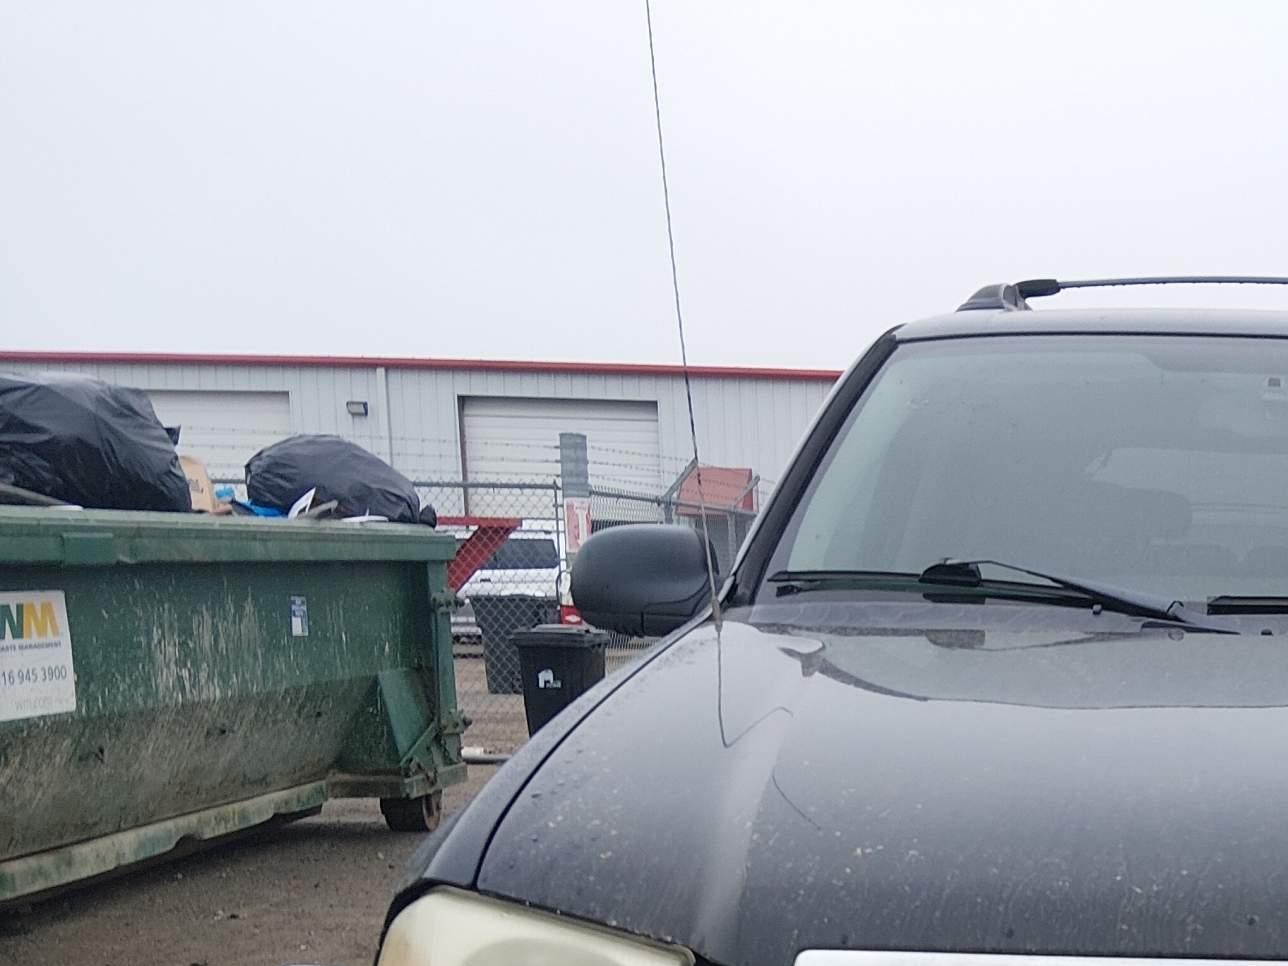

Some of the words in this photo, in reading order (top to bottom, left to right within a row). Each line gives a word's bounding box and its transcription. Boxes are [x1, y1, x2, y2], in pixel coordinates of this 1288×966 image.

[0, 644, 16, 652] ASTE
[18, 641, 62, 651] MANAGEMENT
[1, 669, 15, 686] 16
[17, 667, 38, 684] 945
[41, 665, 67, 682] 3900
